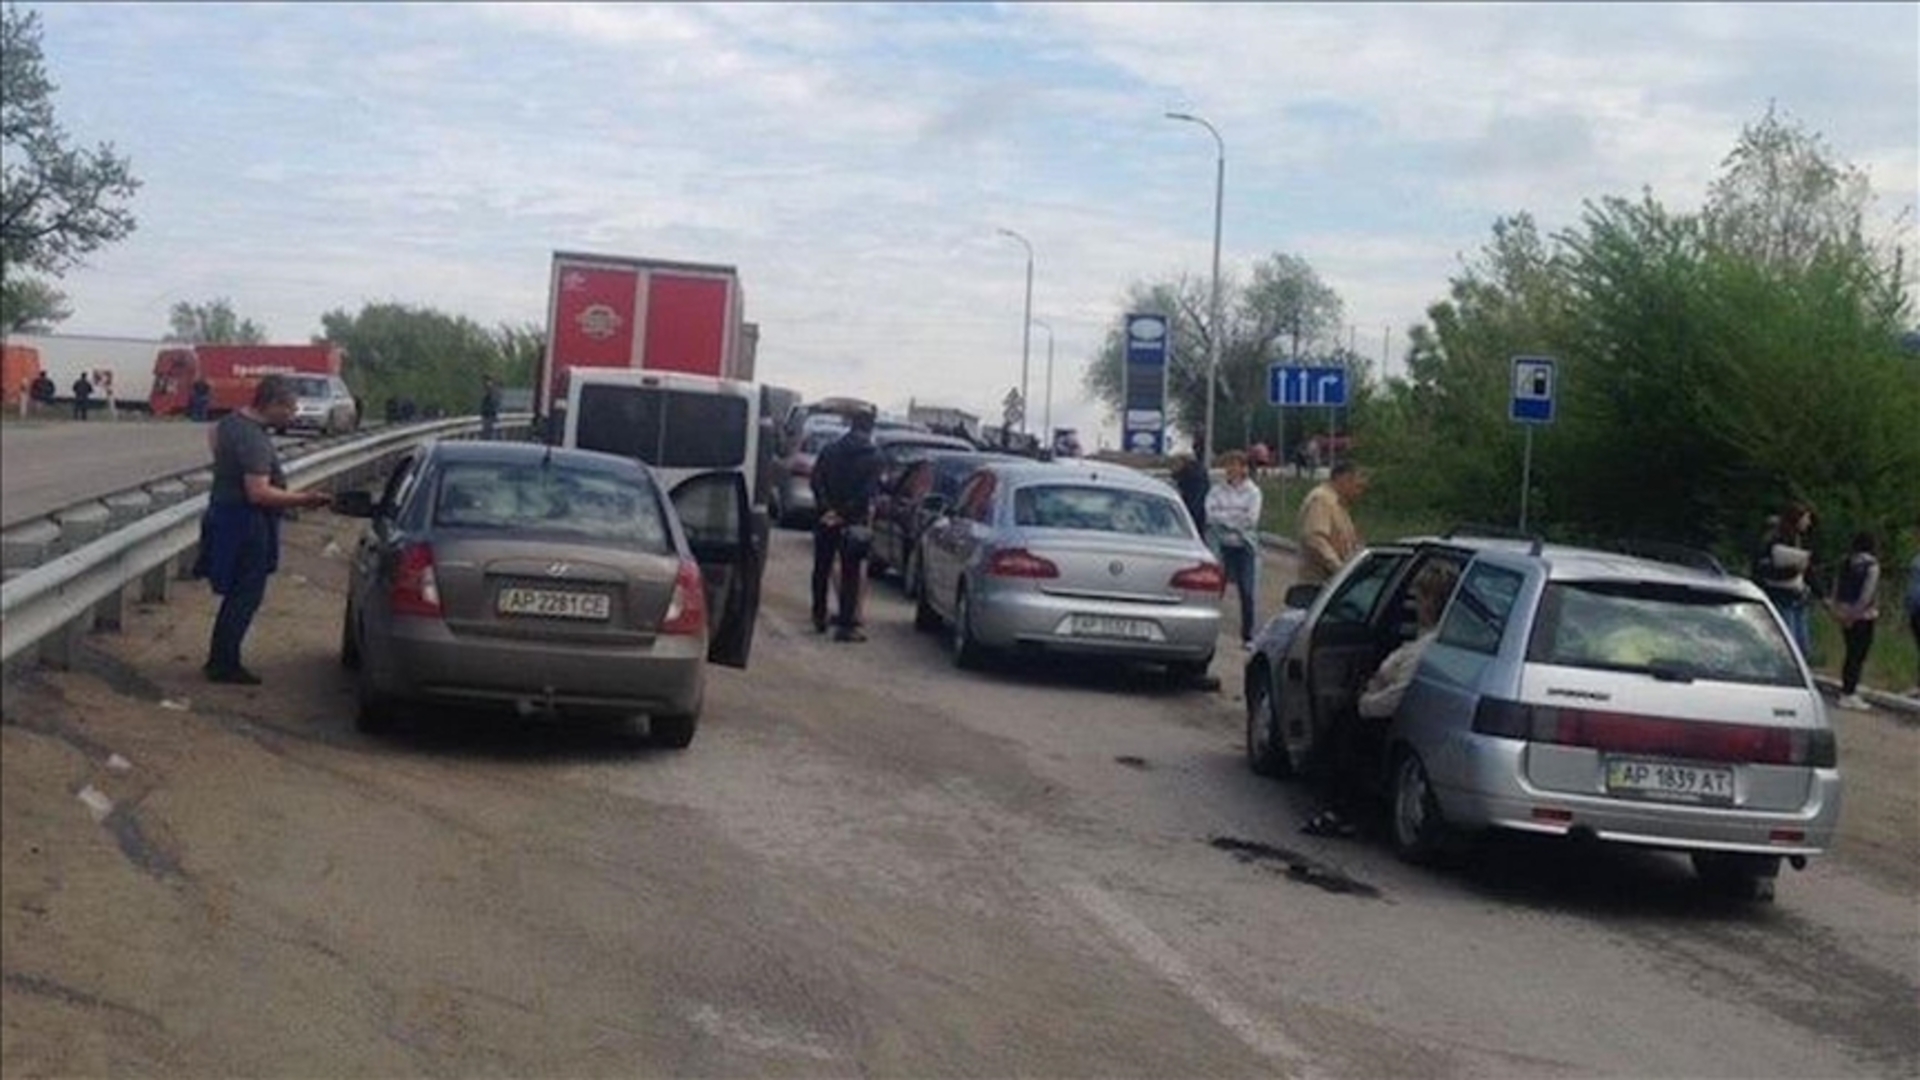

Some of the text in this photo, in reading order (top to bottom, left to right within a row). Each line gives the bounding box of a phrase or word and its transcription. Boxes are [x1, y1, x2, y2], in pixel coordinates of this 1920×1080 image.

[510, 591, 536, 608] AP
[1623, 764, 1727, 791] AP 1839 AT
